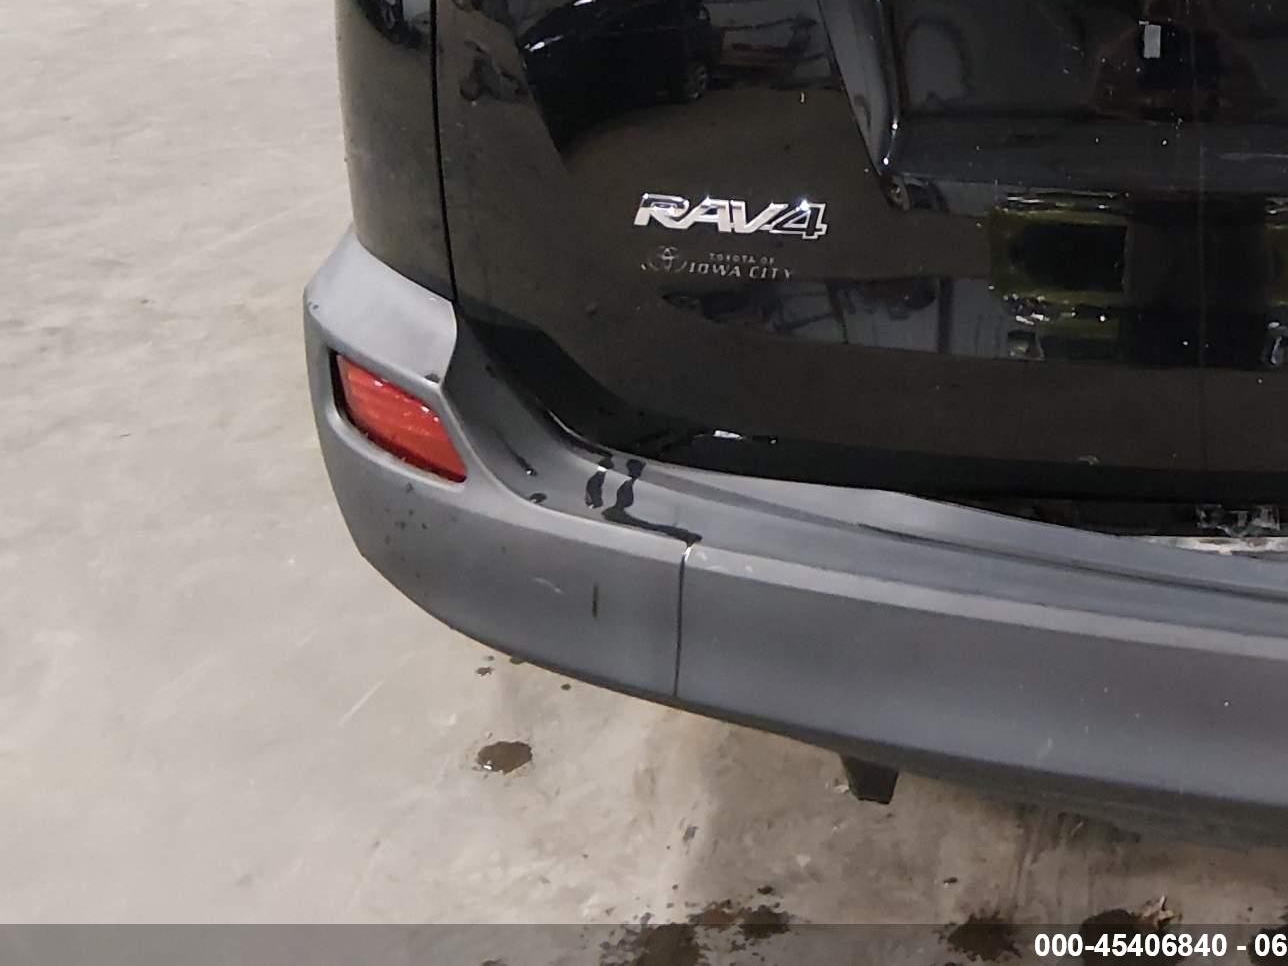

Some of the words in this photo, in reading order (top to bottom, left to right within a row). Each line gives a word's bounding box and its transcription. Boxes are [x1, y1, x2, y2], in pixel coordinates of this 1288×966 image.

[634, 193, 828, 240] RAV4
[709, 252, 756, 263] TOYOTA
[760, 256, 774, 265] OF
[688, 262, 741, 277] IOWA
[749, 265, 793, 280] CITY
